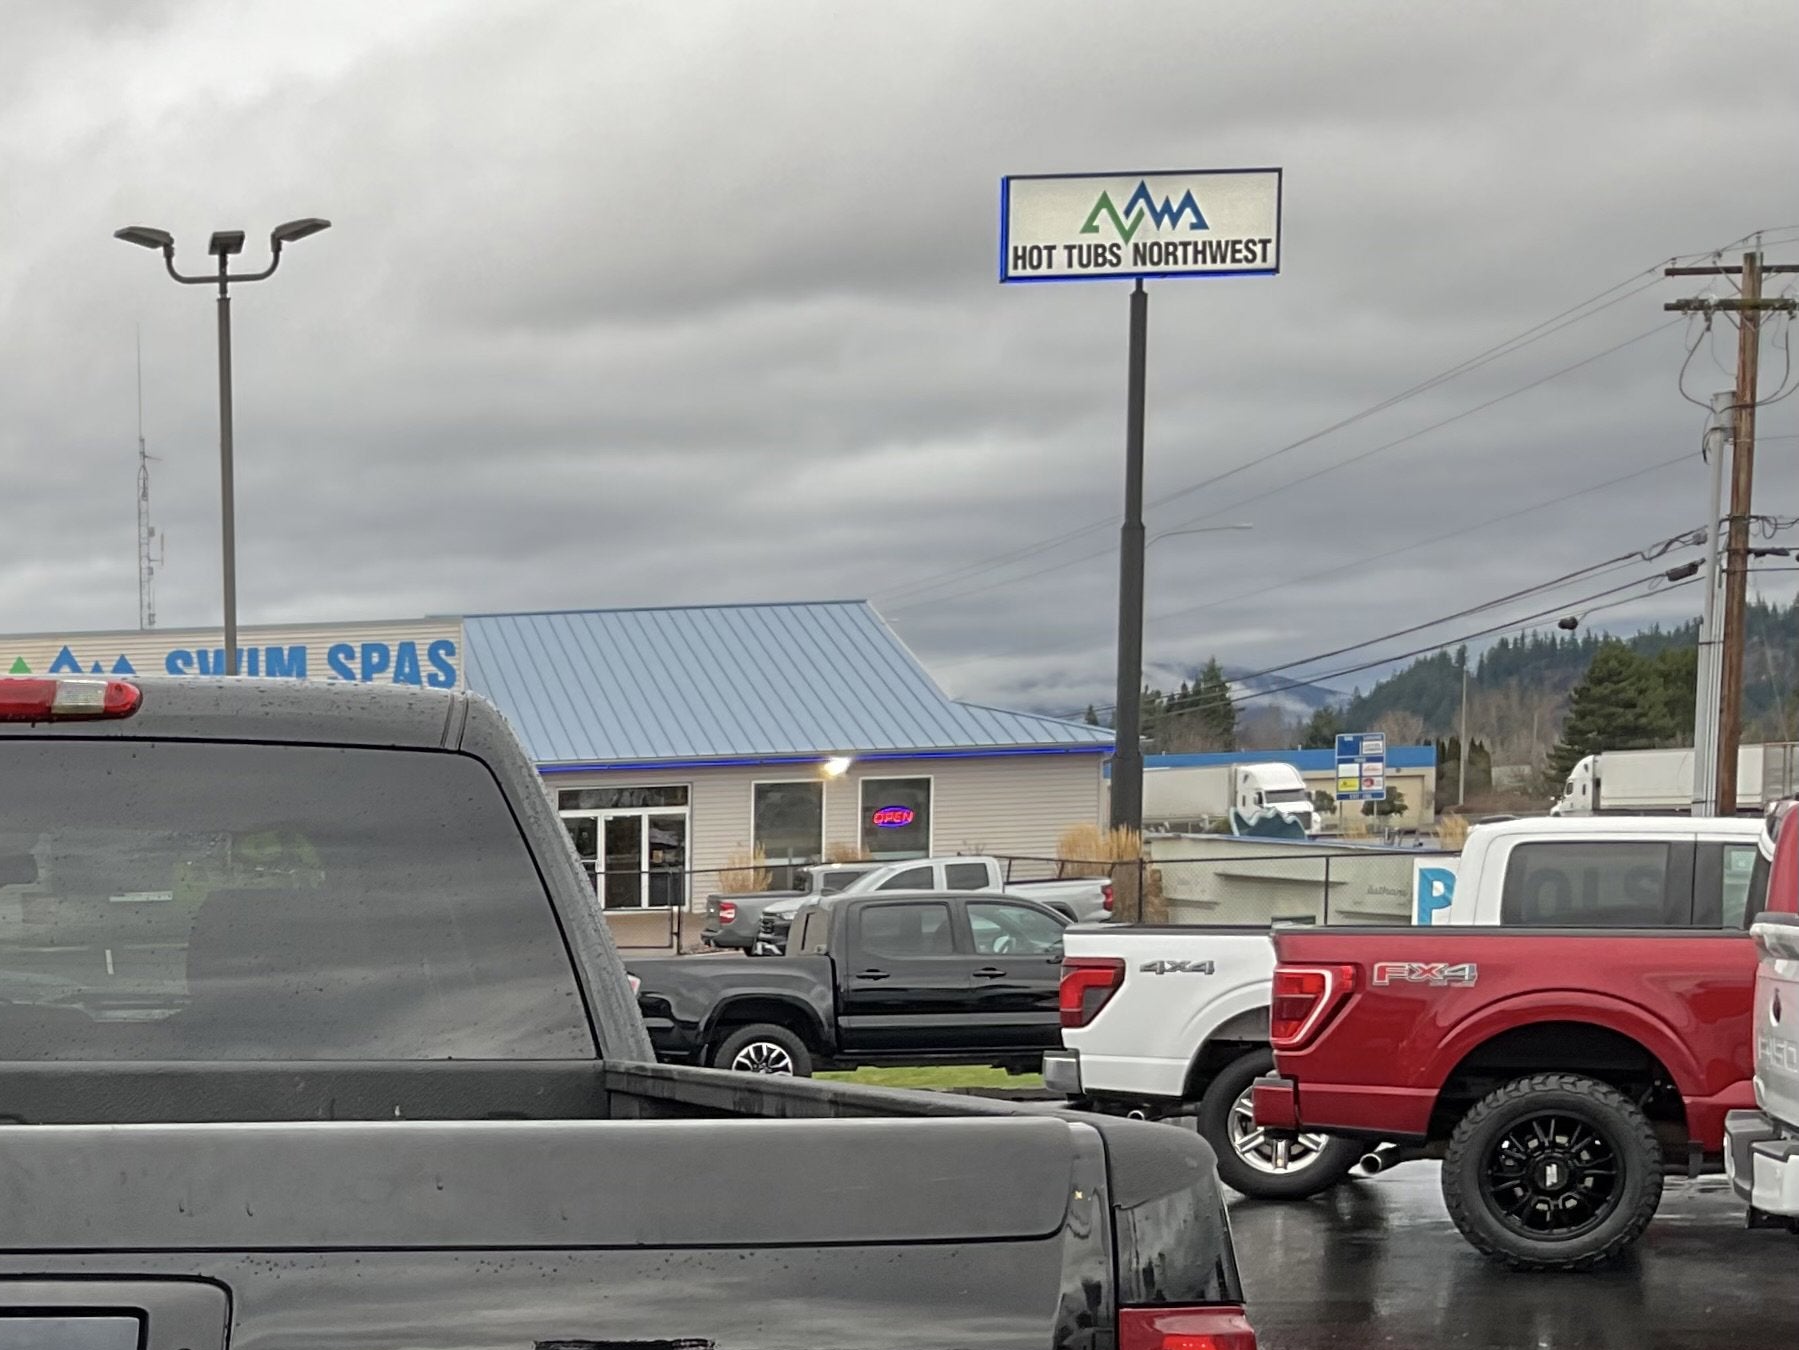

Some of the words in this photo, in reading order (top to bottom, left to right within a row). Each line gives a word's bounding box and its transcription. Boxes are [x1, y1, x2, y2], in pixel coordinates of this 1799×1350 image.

[1012, 244, 1057, 271] HOT
[1063, 242, 1122, 269] TUBS
[1132, 238, 1273, 267] NORTHWEST
[326, 639, 458, 690] SPAS
[873, 809, 914, 824] OPEN
[1372, 961, 1478, 987] FX4
